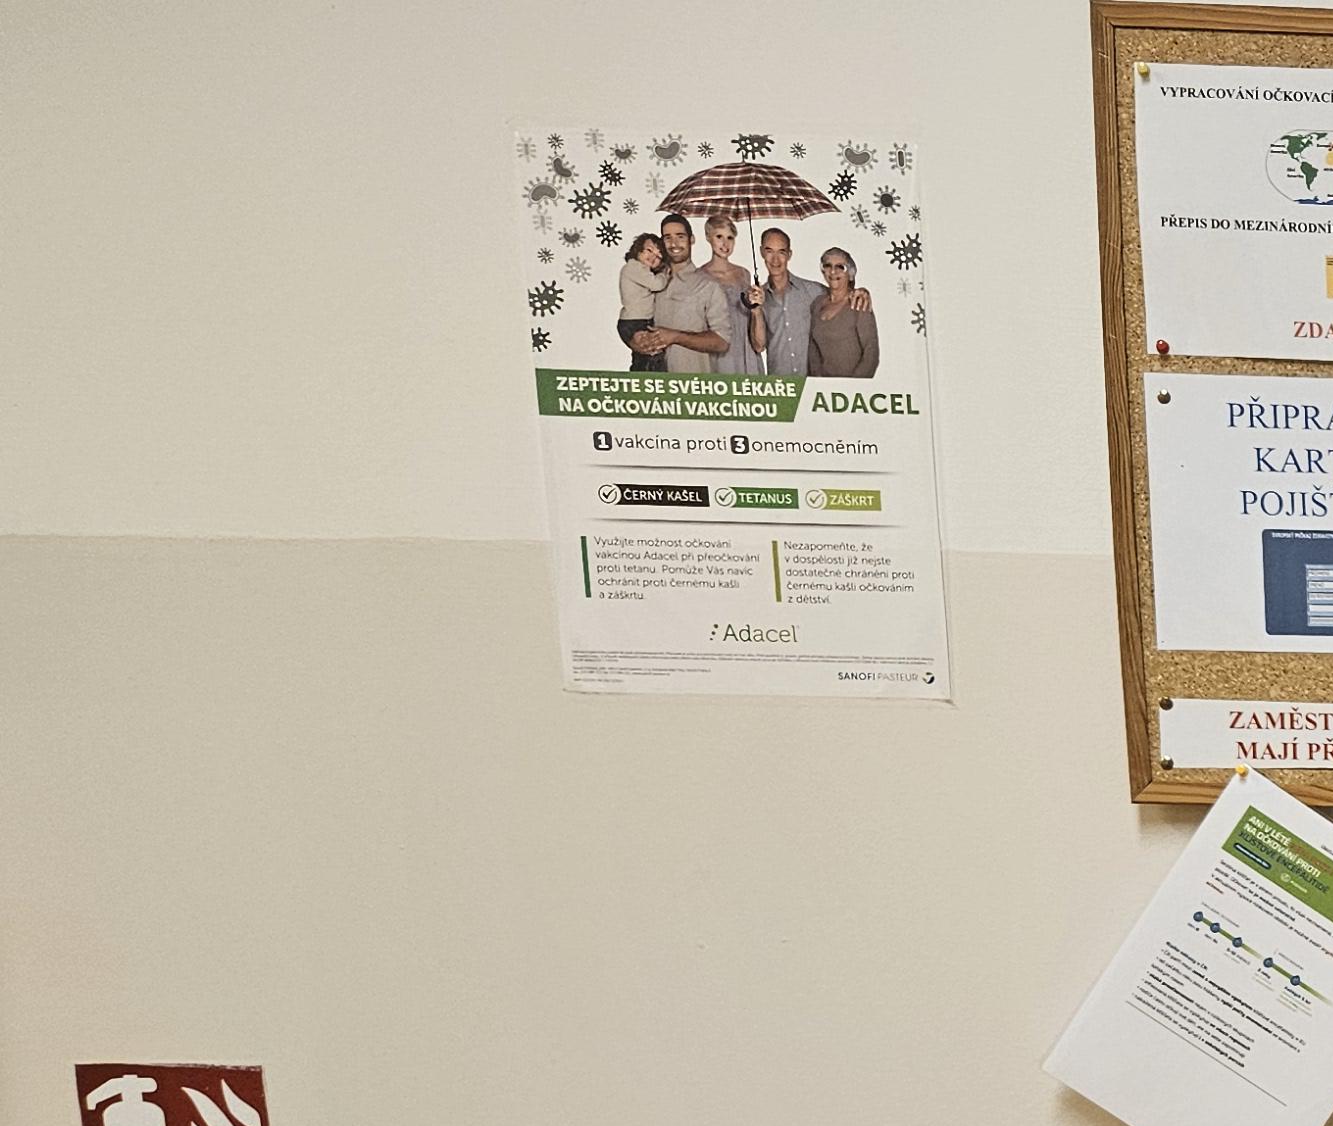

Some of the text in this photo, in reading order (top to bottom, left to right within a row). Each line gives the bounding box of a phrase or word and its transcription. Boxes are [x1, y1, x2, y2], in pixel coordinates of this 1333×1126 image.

[1160, 86, 1259, 100] VYPRACOVÁNÍ
[1160, 214, 1207, 229] PŘEPIS
[1211, 218, 1231, 230] DO
[556, 377, 796, 397] ZEPTEJTE SE SVÉHO LÉKAŘE
[559, 398, 777, 418] NA OČKOVÁNÍ VAKCÍNOU
[812, 392, 920, 415] ADACEL
[615, 436, 681, 450] vakcína
[687, 437, 727, 453] proti
[751, 439, 878, 455] onemocněním
[623, 488, 703, 503] ČERNÝ KAŠEL
[738, 492, 792, 504] TETANUS
[830, 492, 874, 506] ZÁŠKRT
[594, 536, 731, 548] Využijte možnost očkování
[784, 541, 873, 552] Nezapomeňte, že
[595, 551, 640, 559] vakcínou
[644, 551, 678, 561] Adacel
[681, 553, 694, 562] při
[793, 555, 844, 565] dospělosti
[847, 556, 858, 566] již
[861, 557, 891, 567] nejste
[597, 564, 620, 573] proti
[662, 564, 703, 575] Pomůže
[706, 565, 724, 575] Vás
[727, 566, 753, 575] navíc
[891, 571, 914, 580] proti
[598, 578, 640, 586] ochránit
[643, 578, 667, 587] proti
[669, 578, 715, 588] černému
[787, 582, 832, 591] černému
[722, 624, 798, 643] Adacel
[838, 672, 918, 681] SANOFI PASTEUR
[1236, 737, 1301, 761] MAJÍ
